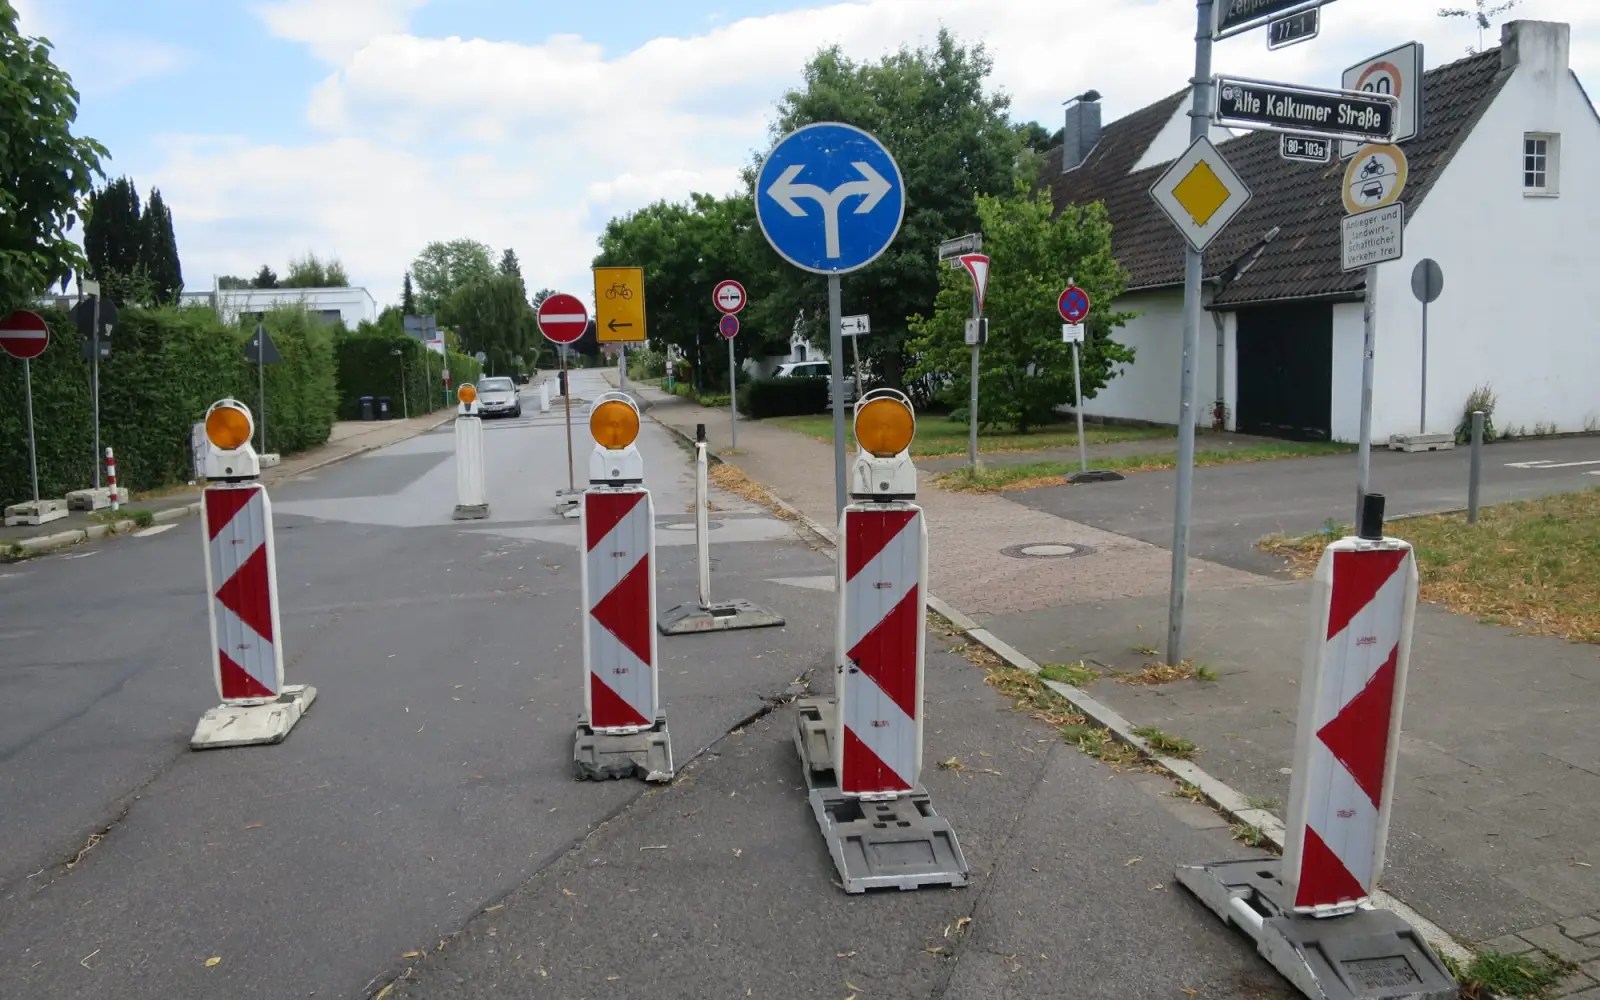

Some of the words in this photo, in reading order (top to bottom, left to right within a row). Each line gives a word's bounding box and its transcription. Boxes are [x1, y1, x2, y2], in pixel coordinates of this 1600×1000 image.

[1233, 91, 1260, 113] Alte
[1266, 94, 1332, 122] Kalkumer
[1337, 103, 1381, 129] Straße
[1287, 140, 1324, 157] 80-103a
[1347, 216, 1377, 230] Anlieger
[1381, 210, 1397, 221] und
[1348, 235, 1395, 252] schaftlicher
[1348, 251, 1377, 264] Verkehr
[1380, 246, 1396, 257] frei
